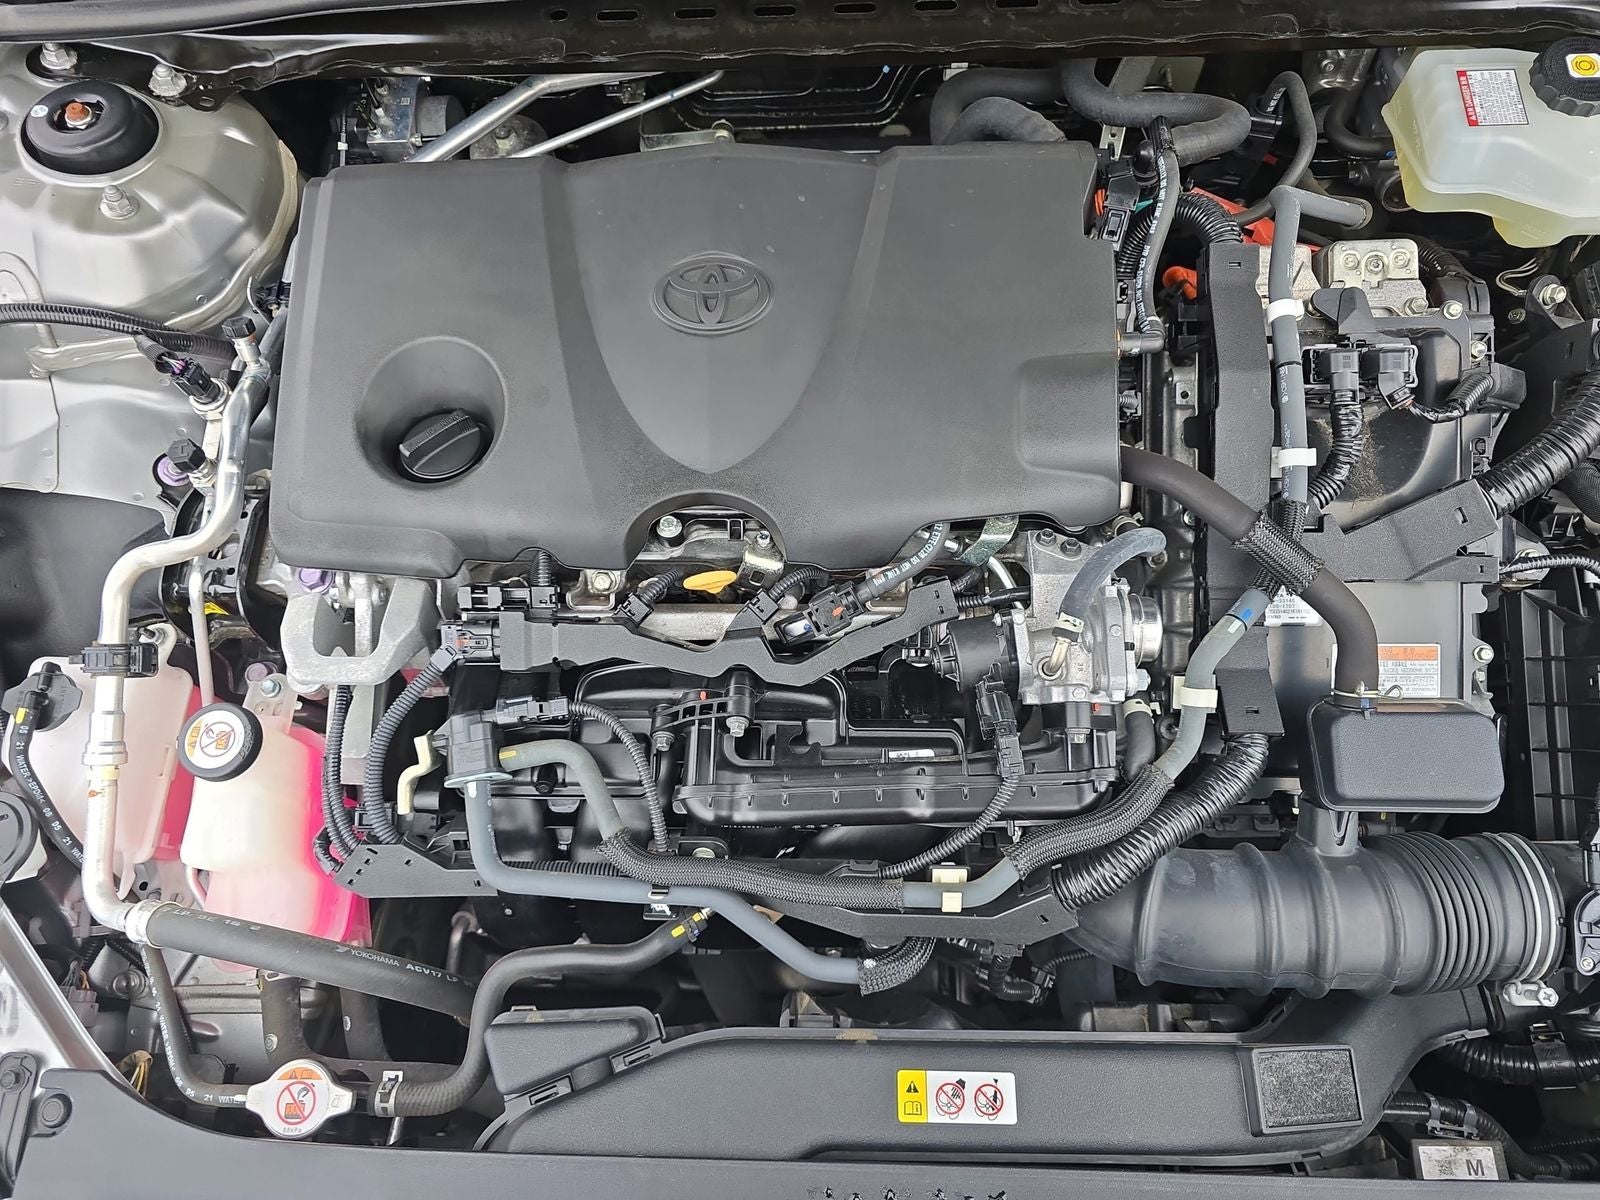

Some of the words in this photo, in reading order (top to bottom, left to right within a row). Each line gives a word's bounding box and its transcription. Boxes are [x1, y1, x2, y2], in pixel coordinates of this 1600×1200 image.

[16, 741, 25, 750] 21
[16, 755, 30, 783] WATER
[62, 836, 73, 846] 21
[71, 847, 86, 862] WATE
[351, 948, 400, 967] YOKOHAMA
[406, 963, 442, 978] ACV17
[204, 1094, 213, 1102] 21
[218, 1096, 244, 1104] WAT
[1465, 1159, 1485, 1176] M
